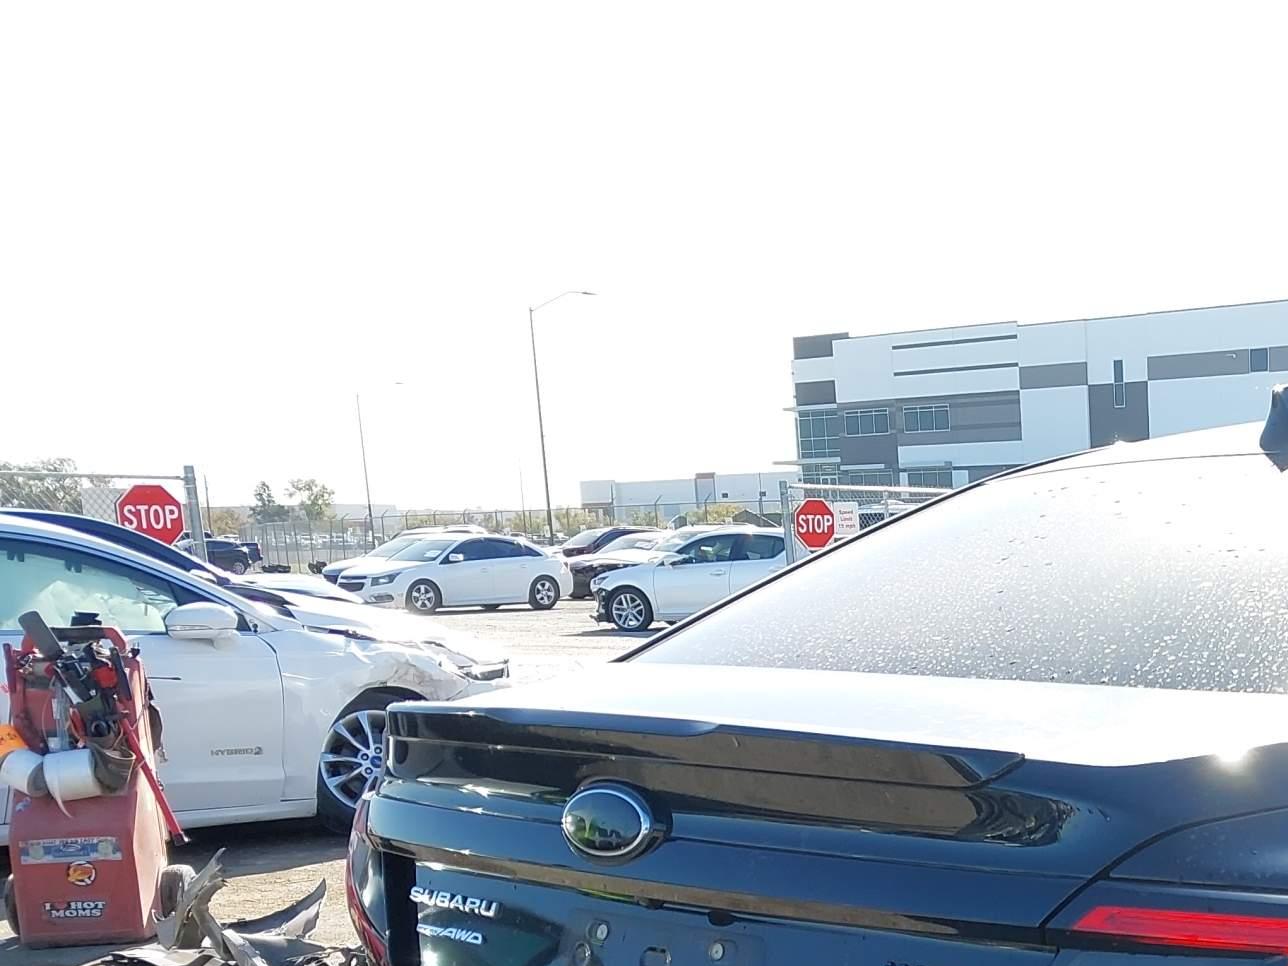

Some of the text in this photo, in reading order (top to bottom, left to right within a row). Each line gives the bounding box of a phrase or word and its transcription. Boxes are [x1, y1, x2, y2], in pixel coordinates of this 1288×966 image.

[123, 504, 179, 530] STOP
[798, 514, 833, 534] STOP
[210, 747, 254, 757] HYBRID
[70, 901, 106, 909] HOT
[409, 886, 497, 918] SUBARU
[51, 909, 102, 918] MOMS
[438, 927, 483, 945] AWD
